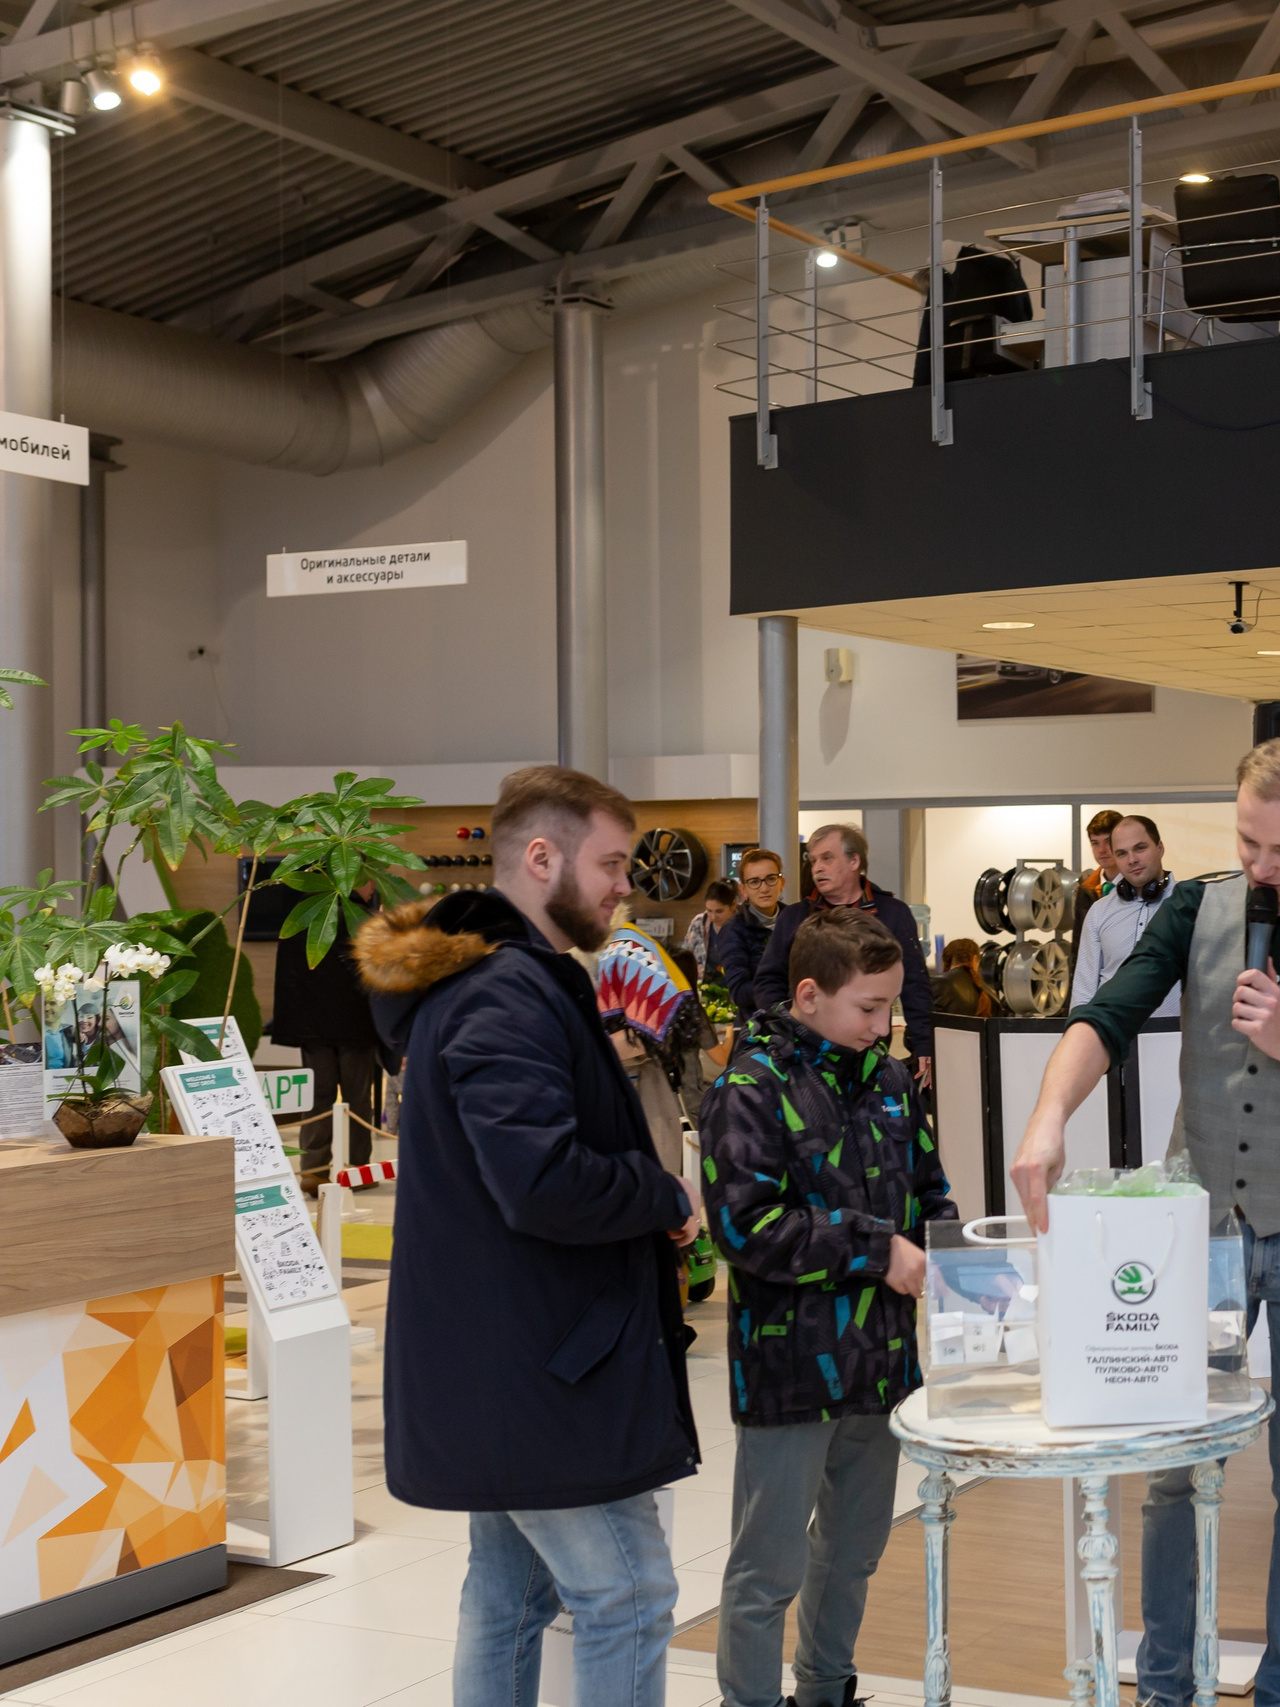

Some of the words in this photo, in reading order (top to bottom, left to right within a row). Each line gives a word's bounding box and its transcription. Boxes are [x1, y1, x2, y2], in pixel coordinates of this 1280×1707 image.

[300, 553, 386, 572] Оригинальные
[389, 551, 431, 566] детали
[326, 574, 334, 584] и
[336, 570, 404, 585] аксессуары
[1106, 1311, 1160, 1322] ŠKODA
[1106, 1322, 1160, 1331] FAMILY
[1086, 1353, 1178, 1364] ТАЛЛИНСКИЙ-АВТО
[1095, 1365, 1169, 1374] ПУЛКОВО-АВТО
[1105, 1375, 1159, 1384] НЕОН-АВТО
